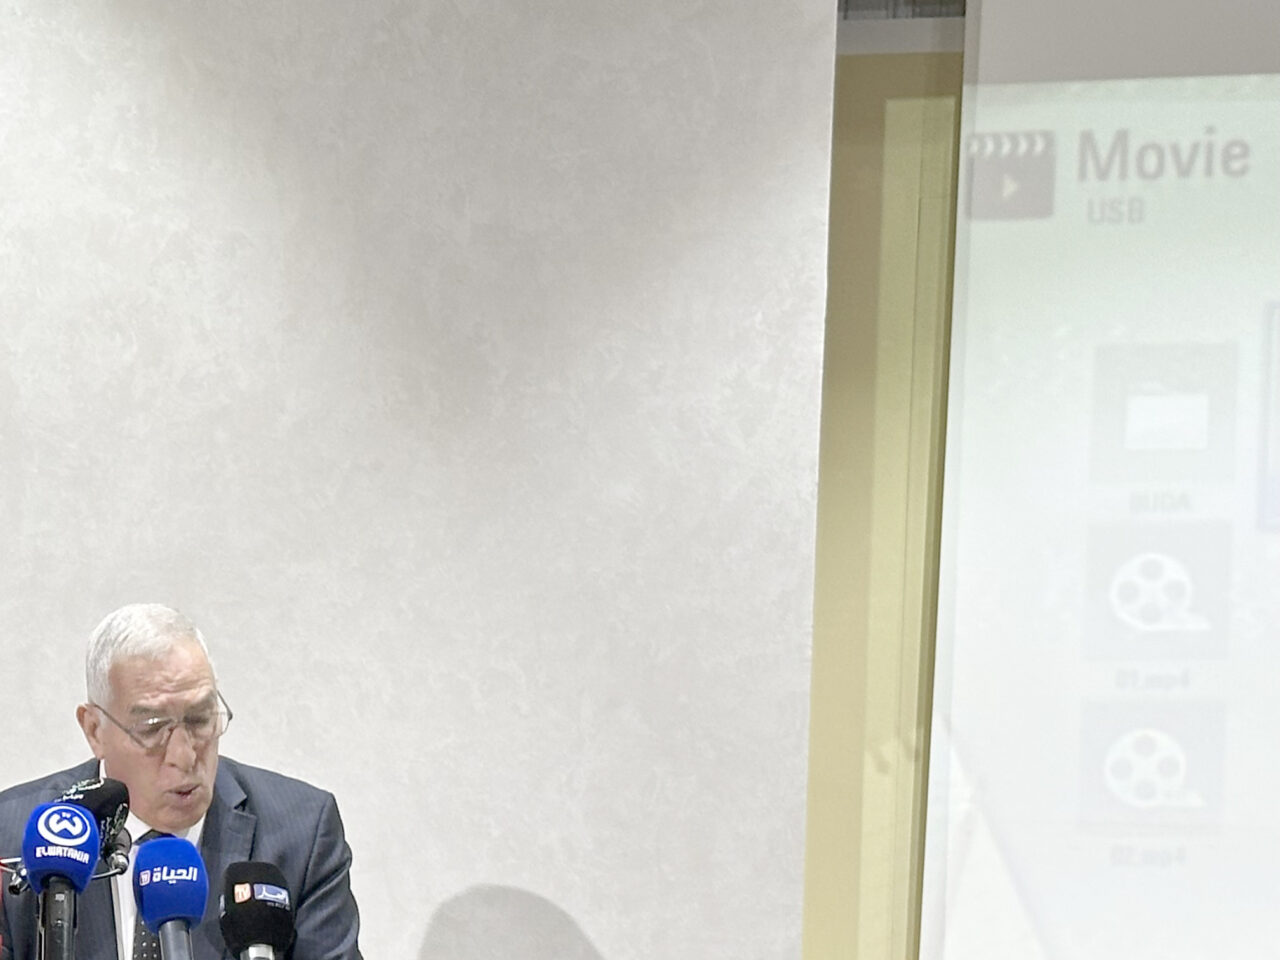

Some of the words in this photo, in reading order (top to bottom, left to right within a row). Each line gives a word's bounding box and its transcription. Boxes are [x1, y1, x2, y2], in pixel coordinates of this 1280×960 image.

[1077, 124, 1251, 183] Movie
[1087, 195, 1146, 226] USB
[35, 844, 90, 864] ELWATANIA
[152, 865, 198, 885] الحياة
